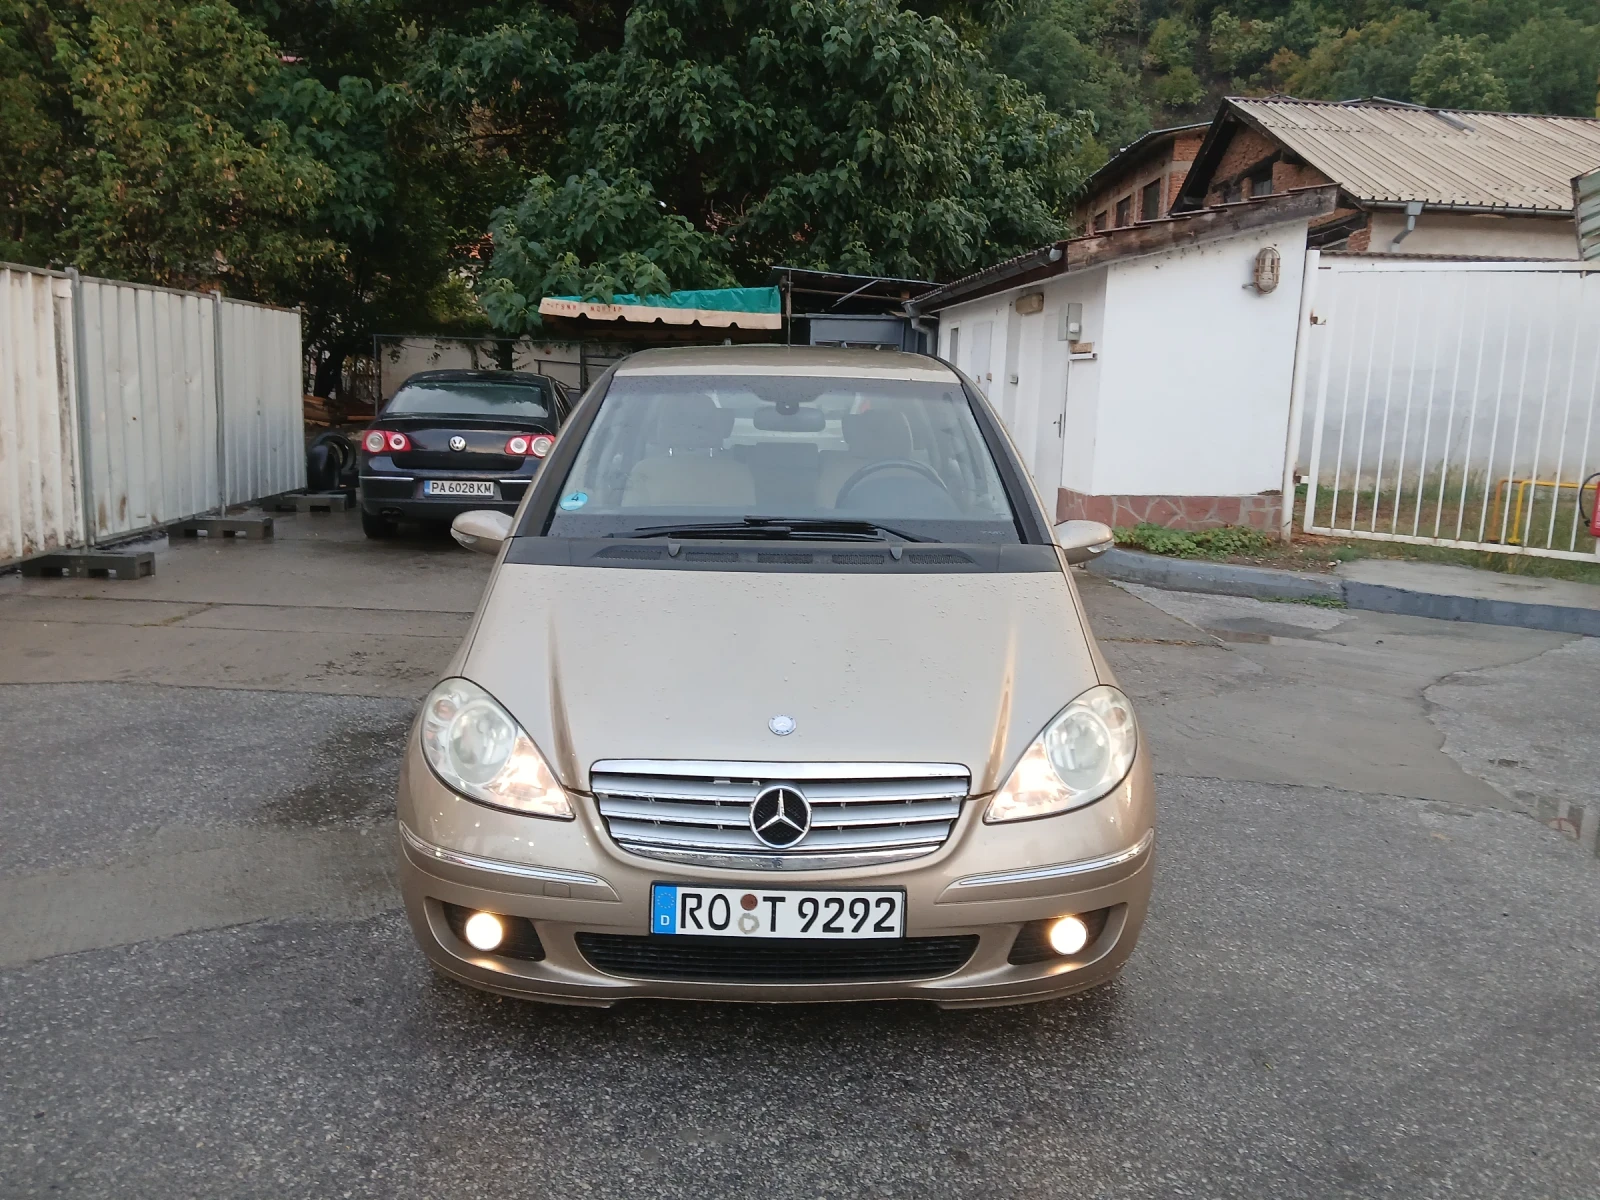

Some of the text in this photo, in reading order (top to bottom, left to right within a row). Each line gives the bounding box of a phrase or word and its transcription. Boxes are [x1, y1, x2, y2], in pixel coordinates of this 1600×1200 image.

[448, 482, 475, 493] 6028
[571, 493, 580, 502] 4
[680, 893, 896, 933] RO T 9292
[660, 915, 670, 926] D
